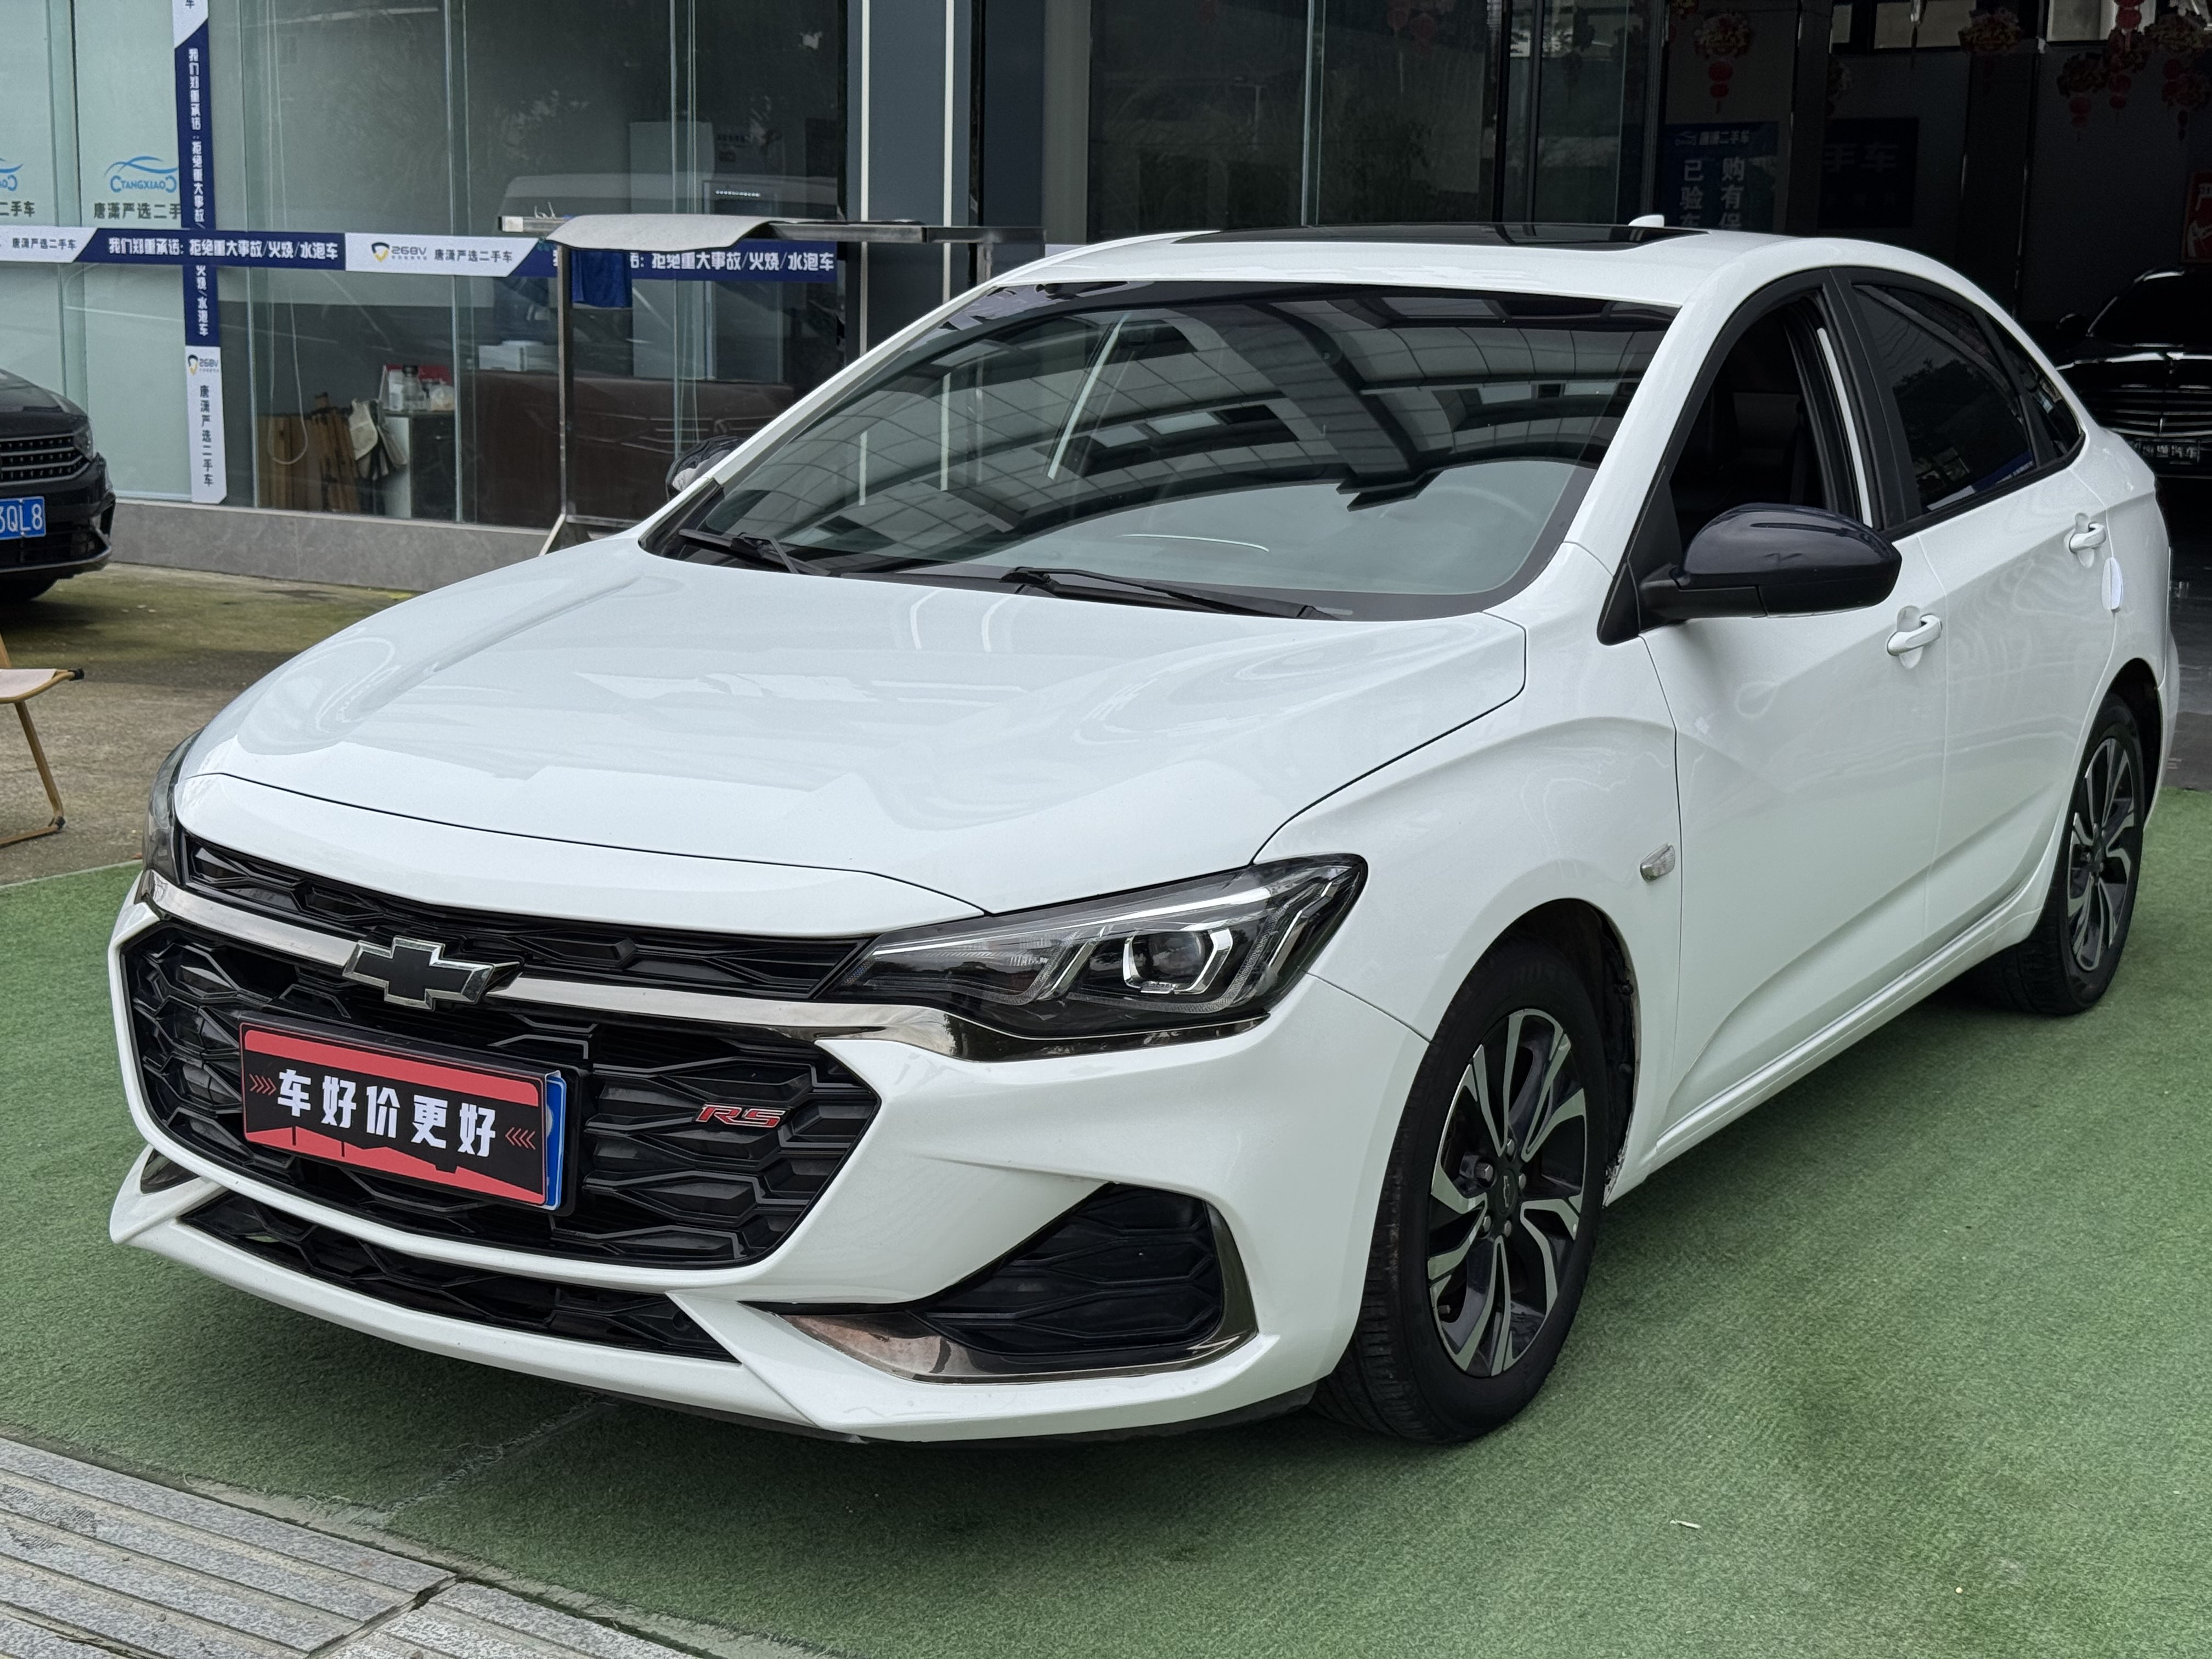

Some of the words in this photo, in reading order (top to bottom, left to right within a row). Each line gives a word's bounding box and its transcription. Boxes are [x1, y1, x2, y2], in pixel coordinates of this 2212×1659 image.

[1699, 130, 1750, 145] 二手车
[391, 246, 427, 256] 268V
[278, 1069, 496, 1157] 车好价更好
[696, 1104, 786, 1128] RS
